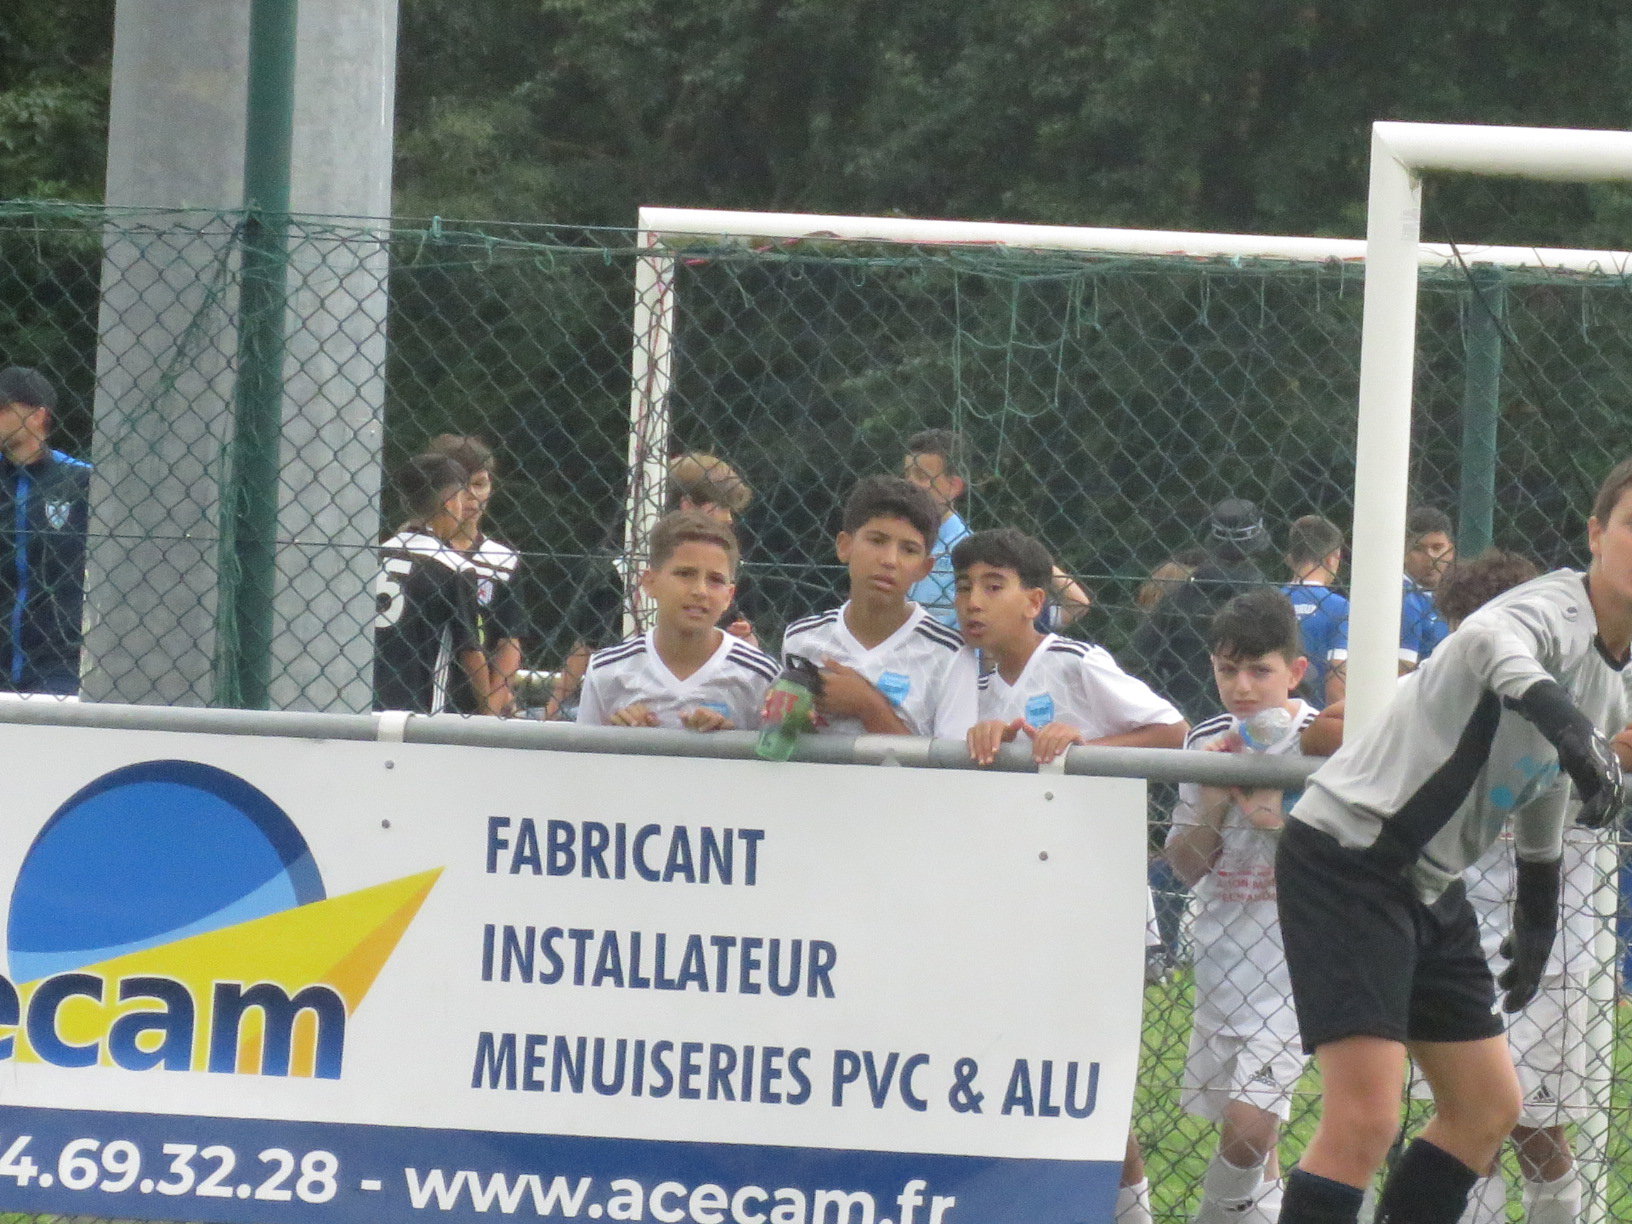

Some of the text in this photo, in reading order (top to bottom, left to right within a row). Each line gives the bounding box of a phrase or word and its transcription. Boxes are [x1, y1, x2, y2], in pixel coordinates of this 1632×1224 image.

[485, 815, 766, 887] FABRICANT
[481, 923, 838, 999] INSTALLATEUR
[0, 972, 346, 1081] cam
[471, 1031, 1101, 1119] MENUISERIES PVC & ALU
